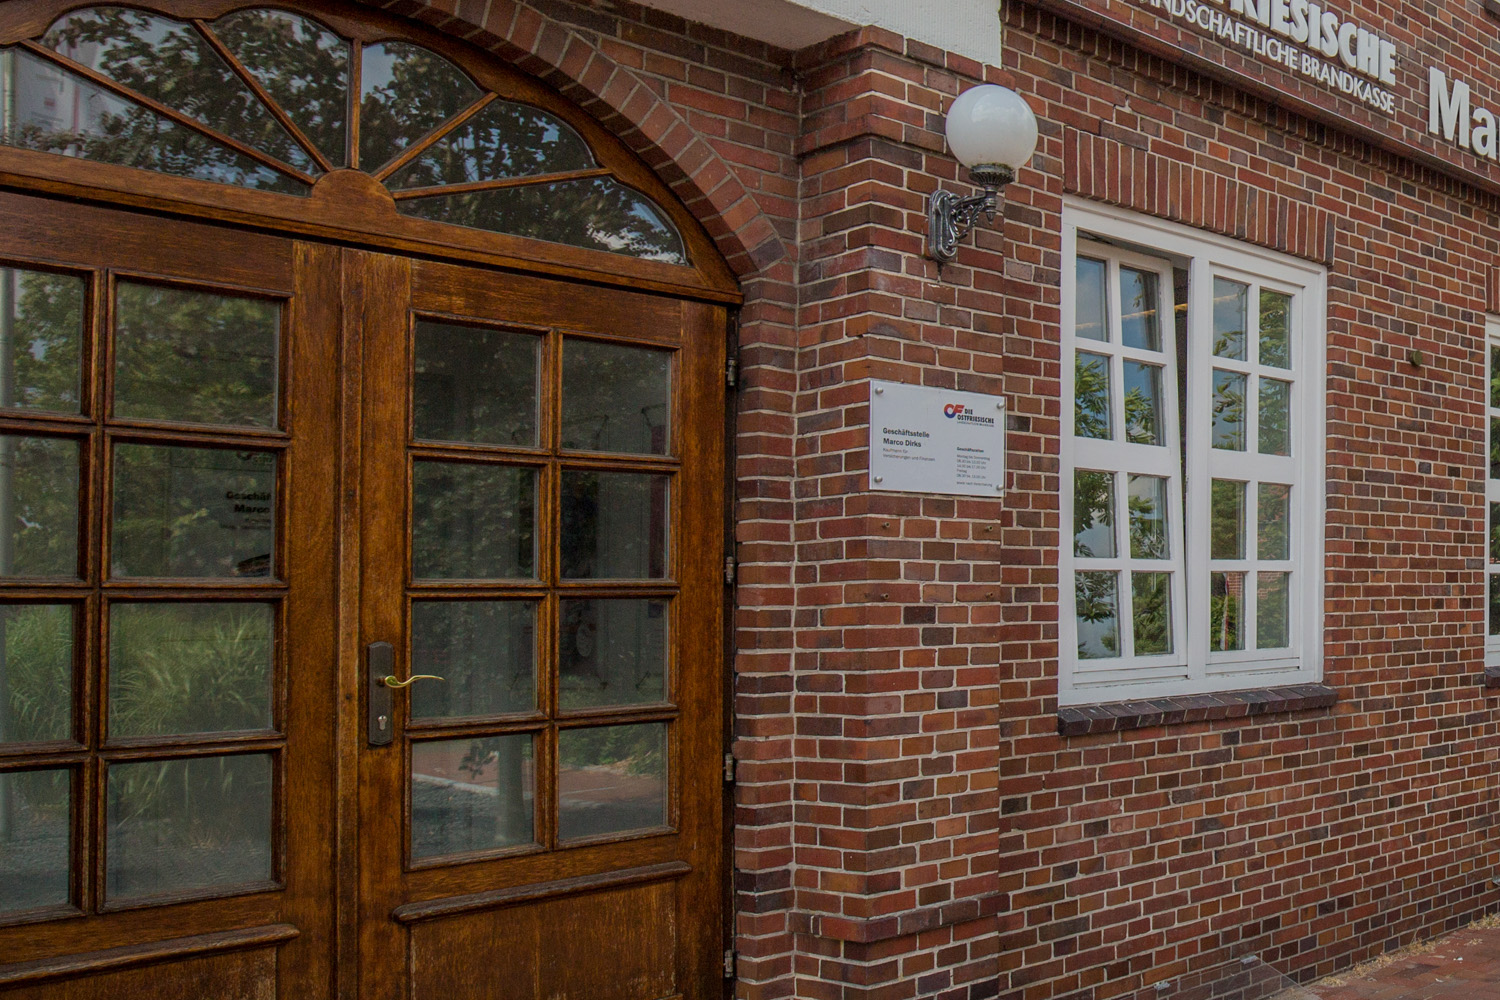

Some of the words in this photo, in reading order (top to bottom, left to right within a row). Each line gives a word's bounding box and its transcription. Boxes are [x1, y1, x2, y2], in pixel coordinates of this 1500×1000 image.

[1301, 55, 1395, 115] BRANDKASSE
[883, 427, 930, 438] Geschäftsstelle
[883, 438, 904, 446] Marco
[905, 439, 922, 447] Dirks
